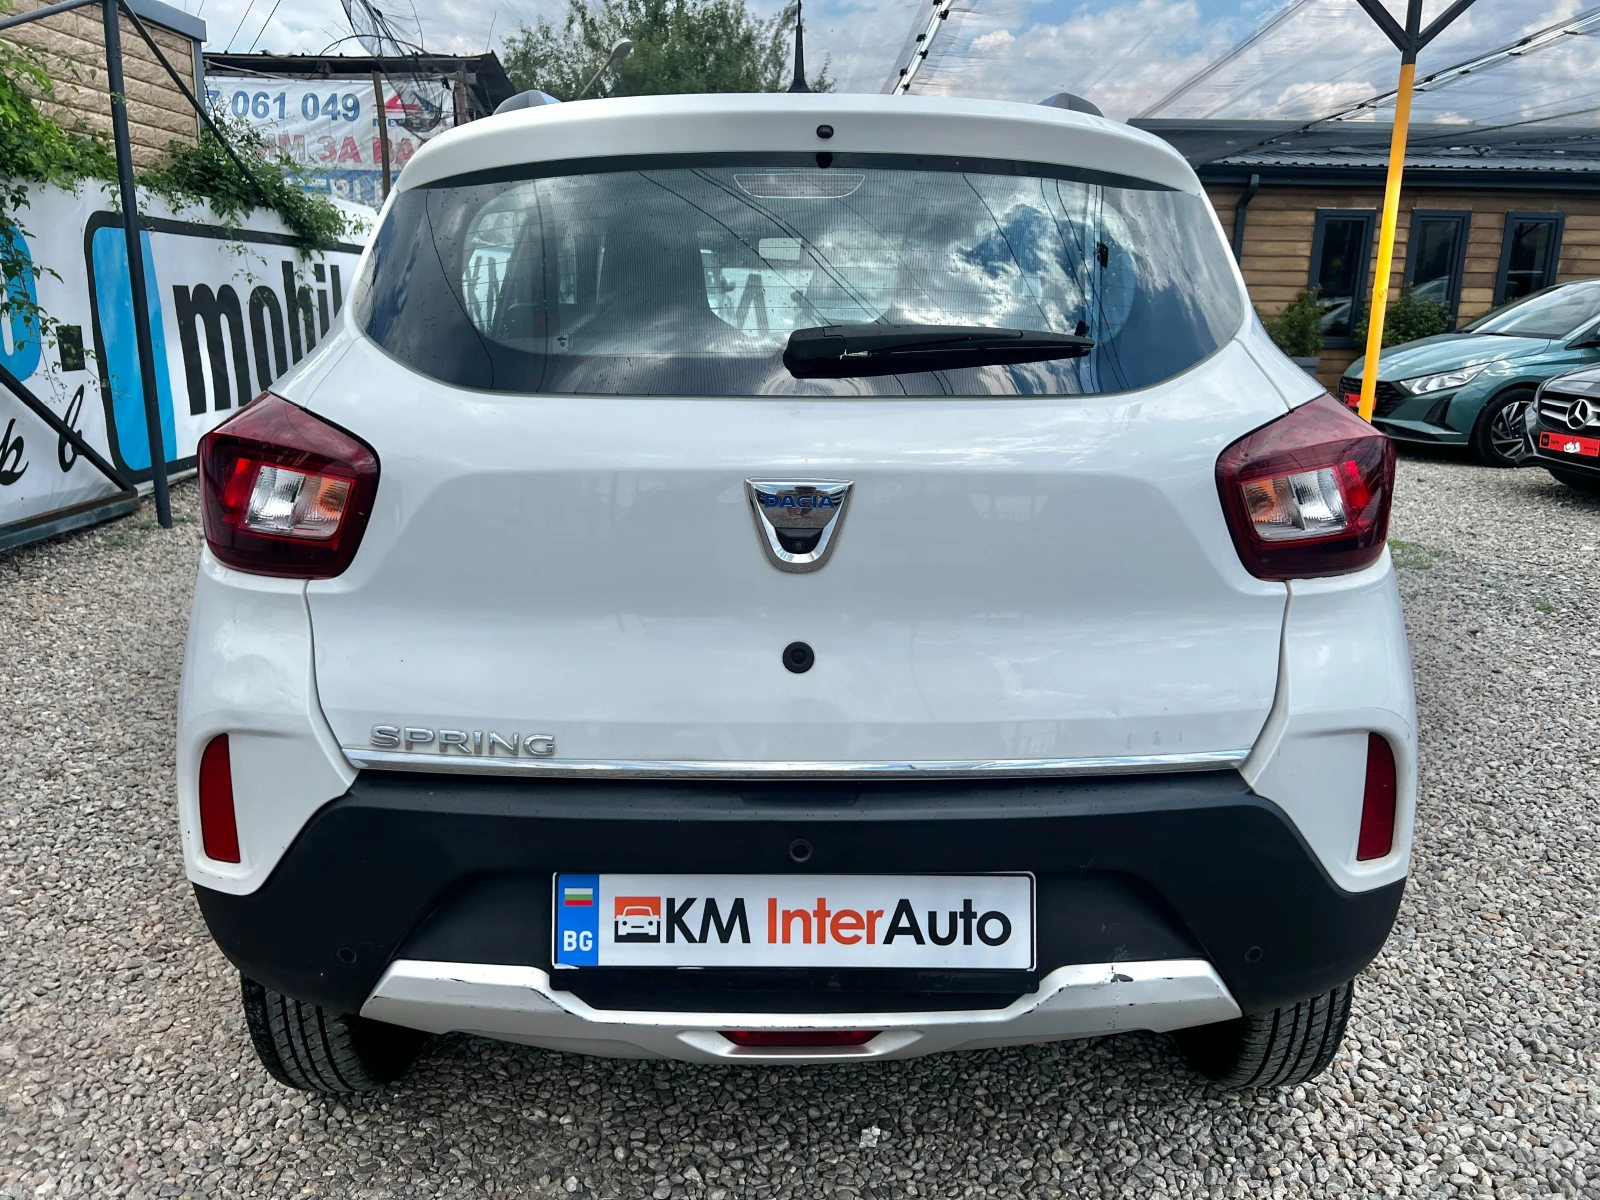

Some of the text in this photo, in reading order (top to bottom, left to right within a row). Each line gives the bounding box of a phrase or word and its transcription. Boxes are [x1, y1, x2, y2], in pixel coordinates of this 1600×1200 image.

[231, 90, 287, 119] 061
[301, 92, 361, 122] 049
[372, 136, 428, 164] ВА
[763, 494, 835, 509] DACIA
[371, 725, 555, 757] SPRING
[665, 897, 1013, 947] KM InterAuto
[562, 930, 594, 953] BG
